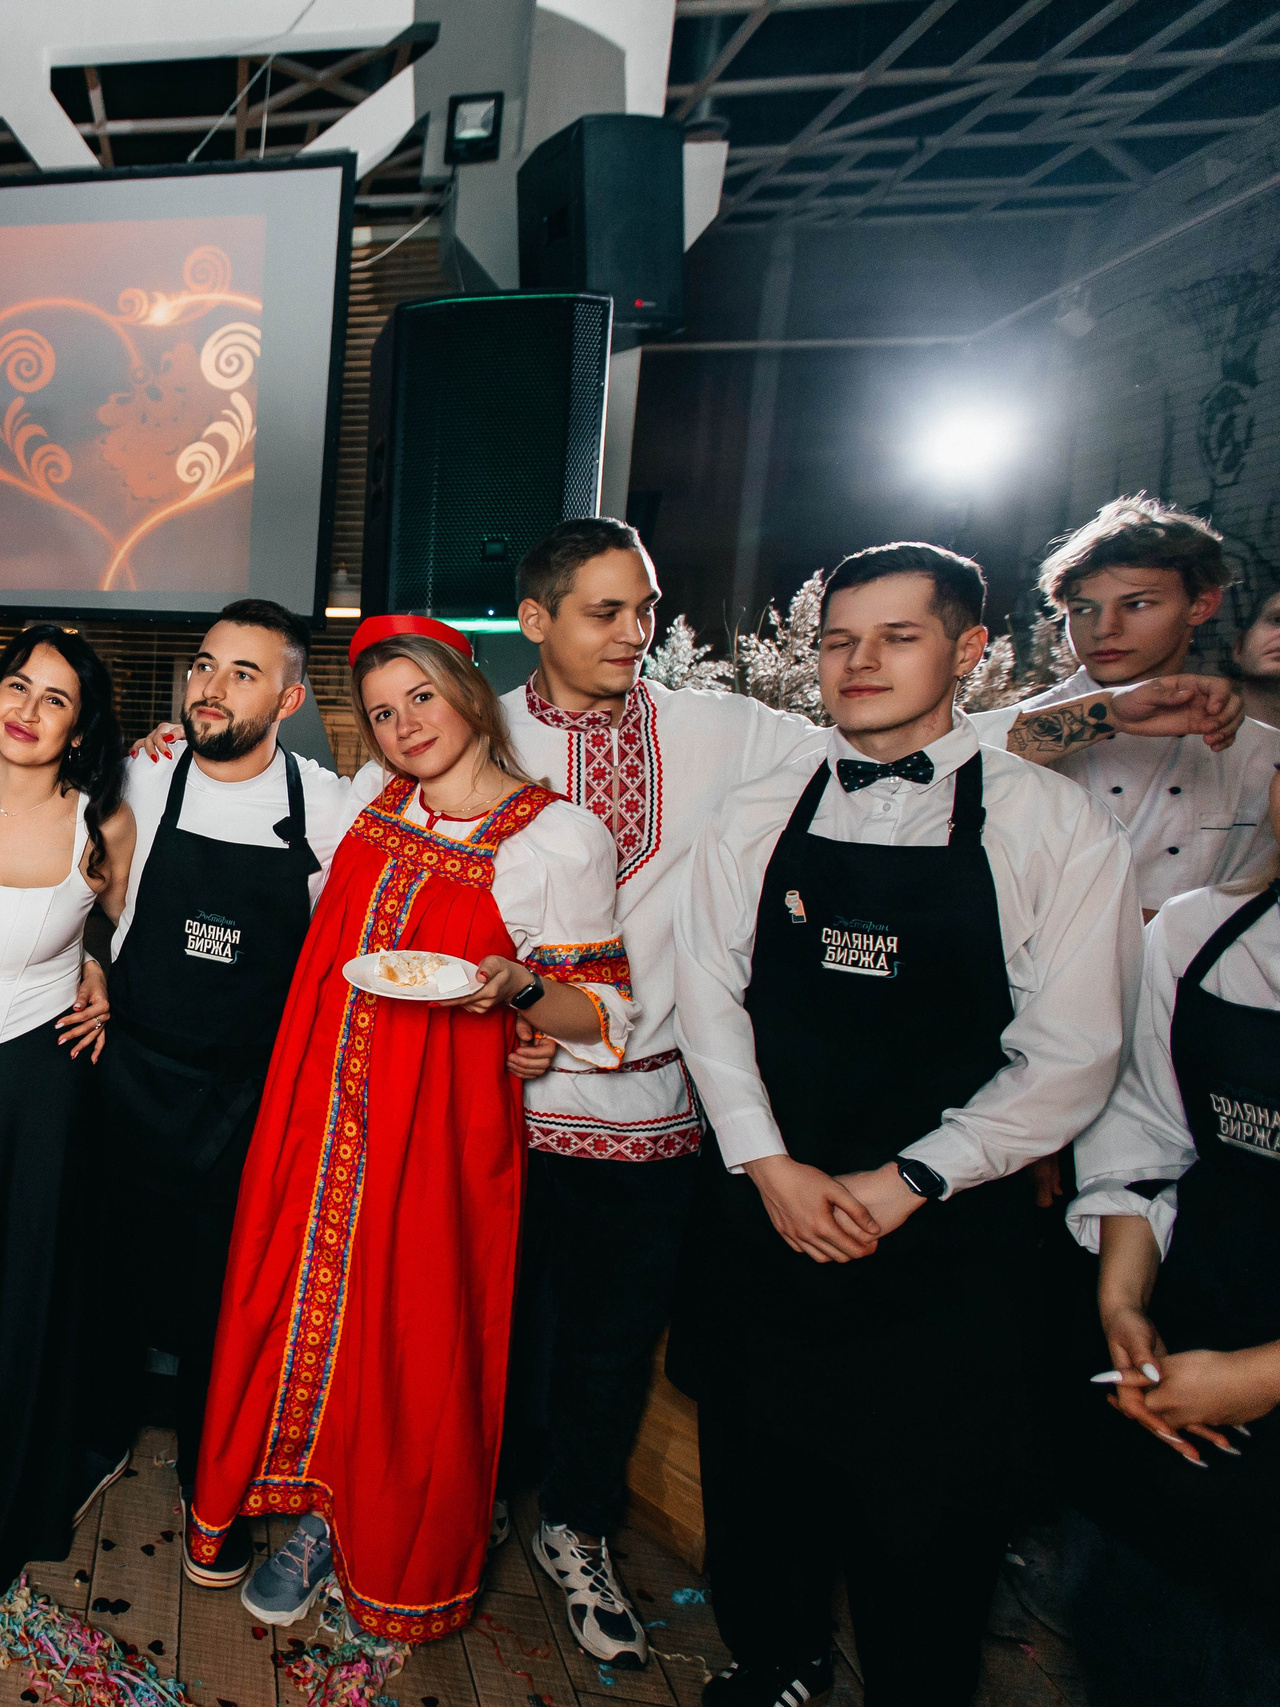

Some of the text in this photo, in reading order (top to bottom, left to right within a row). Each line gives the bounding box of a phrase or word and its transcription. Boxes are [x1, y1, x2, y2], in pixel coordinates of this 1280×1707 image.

[184, 919, 241, 945] СОЛЯНАЯ
[821, 927, 899, 953] СОЛЯНАЯ
[187, 934, 233, 958] БИРЖА
[824, 945, 889, 970] БИРЖА
